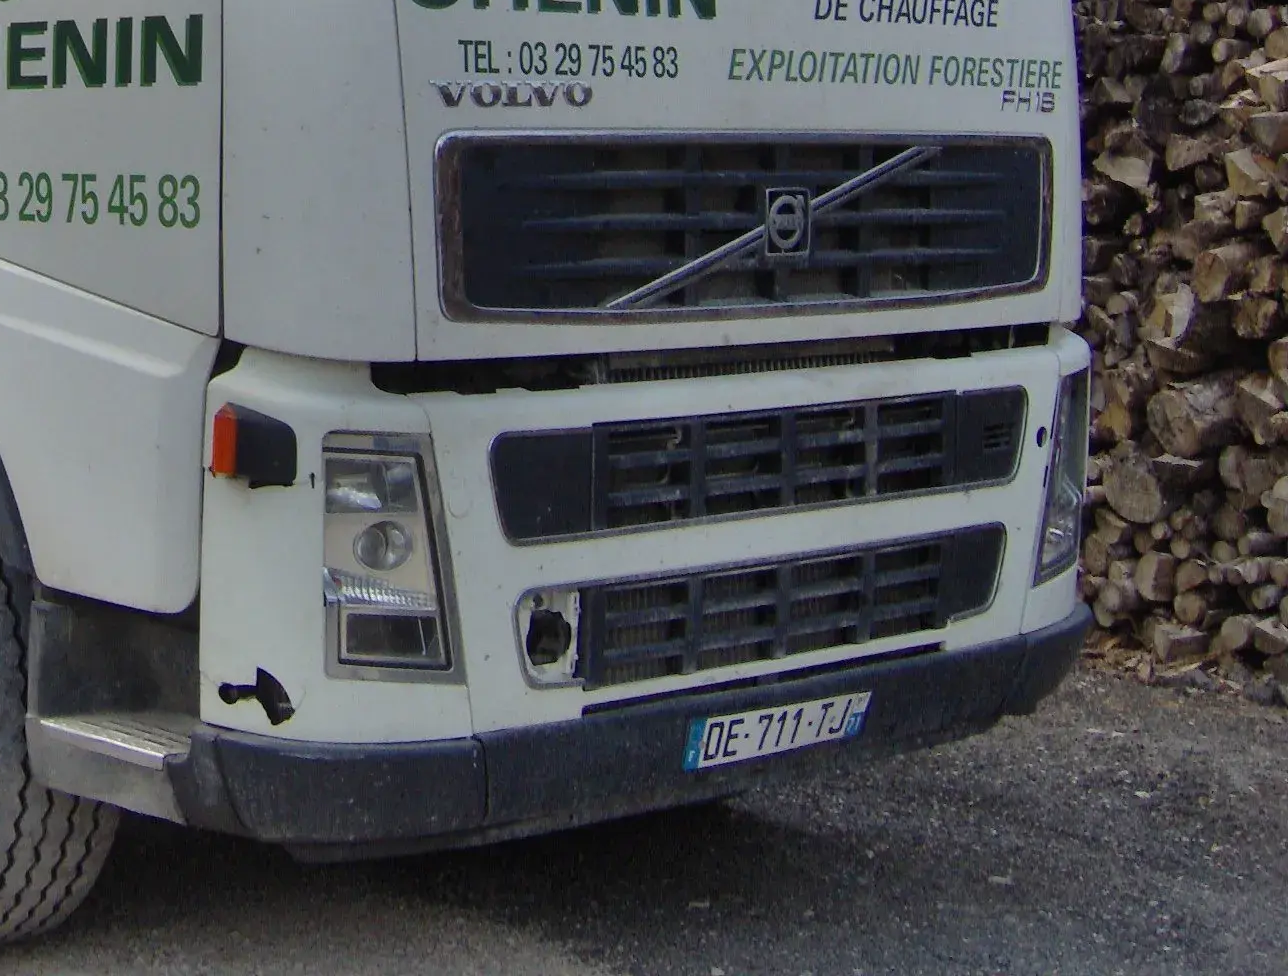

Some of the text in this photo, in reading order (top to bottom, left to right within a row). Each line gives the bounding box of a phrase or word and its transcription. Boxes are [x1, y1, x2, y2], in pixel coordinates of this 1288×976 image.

[519, 41, 548, 75] 03
[554, 42, 581, 76] 29
[588, 44, 614, 77] 75
[620, 45, 647, 78] 45
[653, 46, 678, 78] 83
[727, 48, 1063, 89] EXPLOITATION FORESTIERE
[428, 79, 594, 108] VOLVO
[18, 172, 53, 223] 29
[62, 173, 99, 224] 75
[107, 174, 148, 226] 45
[158, 174, 201, 229] 83
